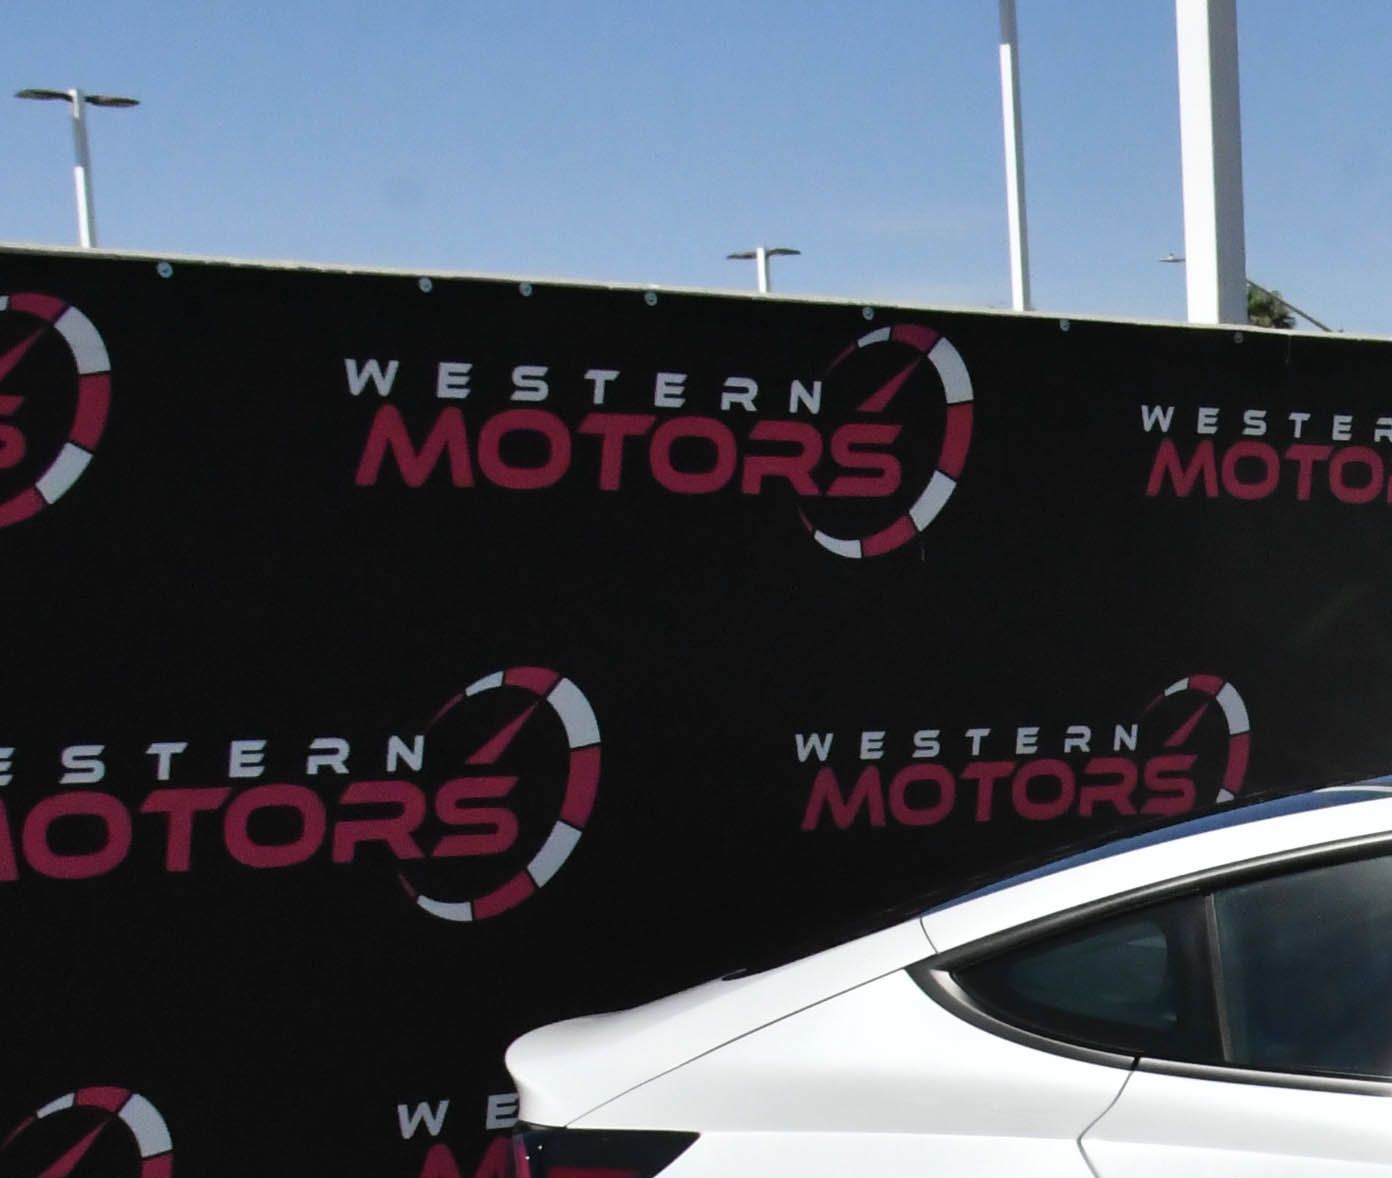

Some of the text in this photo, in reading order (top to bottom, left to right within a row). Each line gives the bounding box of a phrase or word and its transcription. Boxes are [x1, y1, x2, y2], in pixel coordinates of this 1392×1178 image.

[345, 358, 822, 414] WESTERN
[355, 405, 902, 497] MOTORS
[795, 724, 1138, 762] WESTERN
[0, 775, 520, 882] OTORS
[802, 754, 1197, 831] MOTORS
